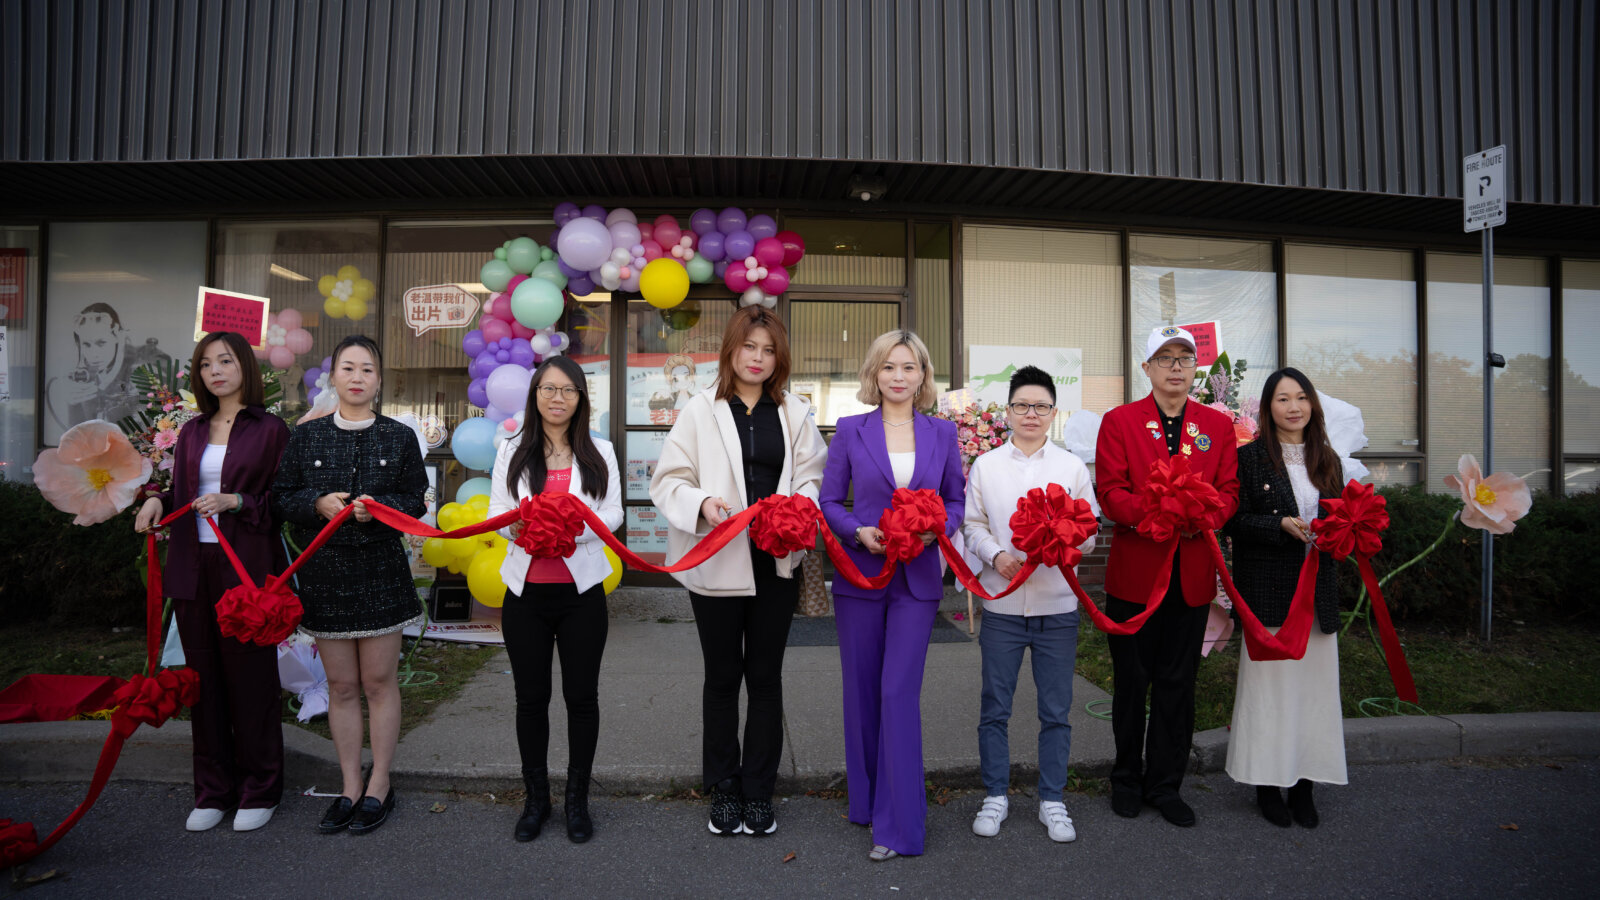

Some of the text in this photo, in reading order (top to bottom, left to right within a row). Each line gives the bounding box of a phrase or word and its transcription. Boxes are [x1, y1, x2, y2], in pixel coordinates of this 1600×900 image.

[1466, 154, 1502, 173] FIRE ROUTE
[410, 292, 465, 304] 老温带我们
[411, 305, 441, 321] 出片
